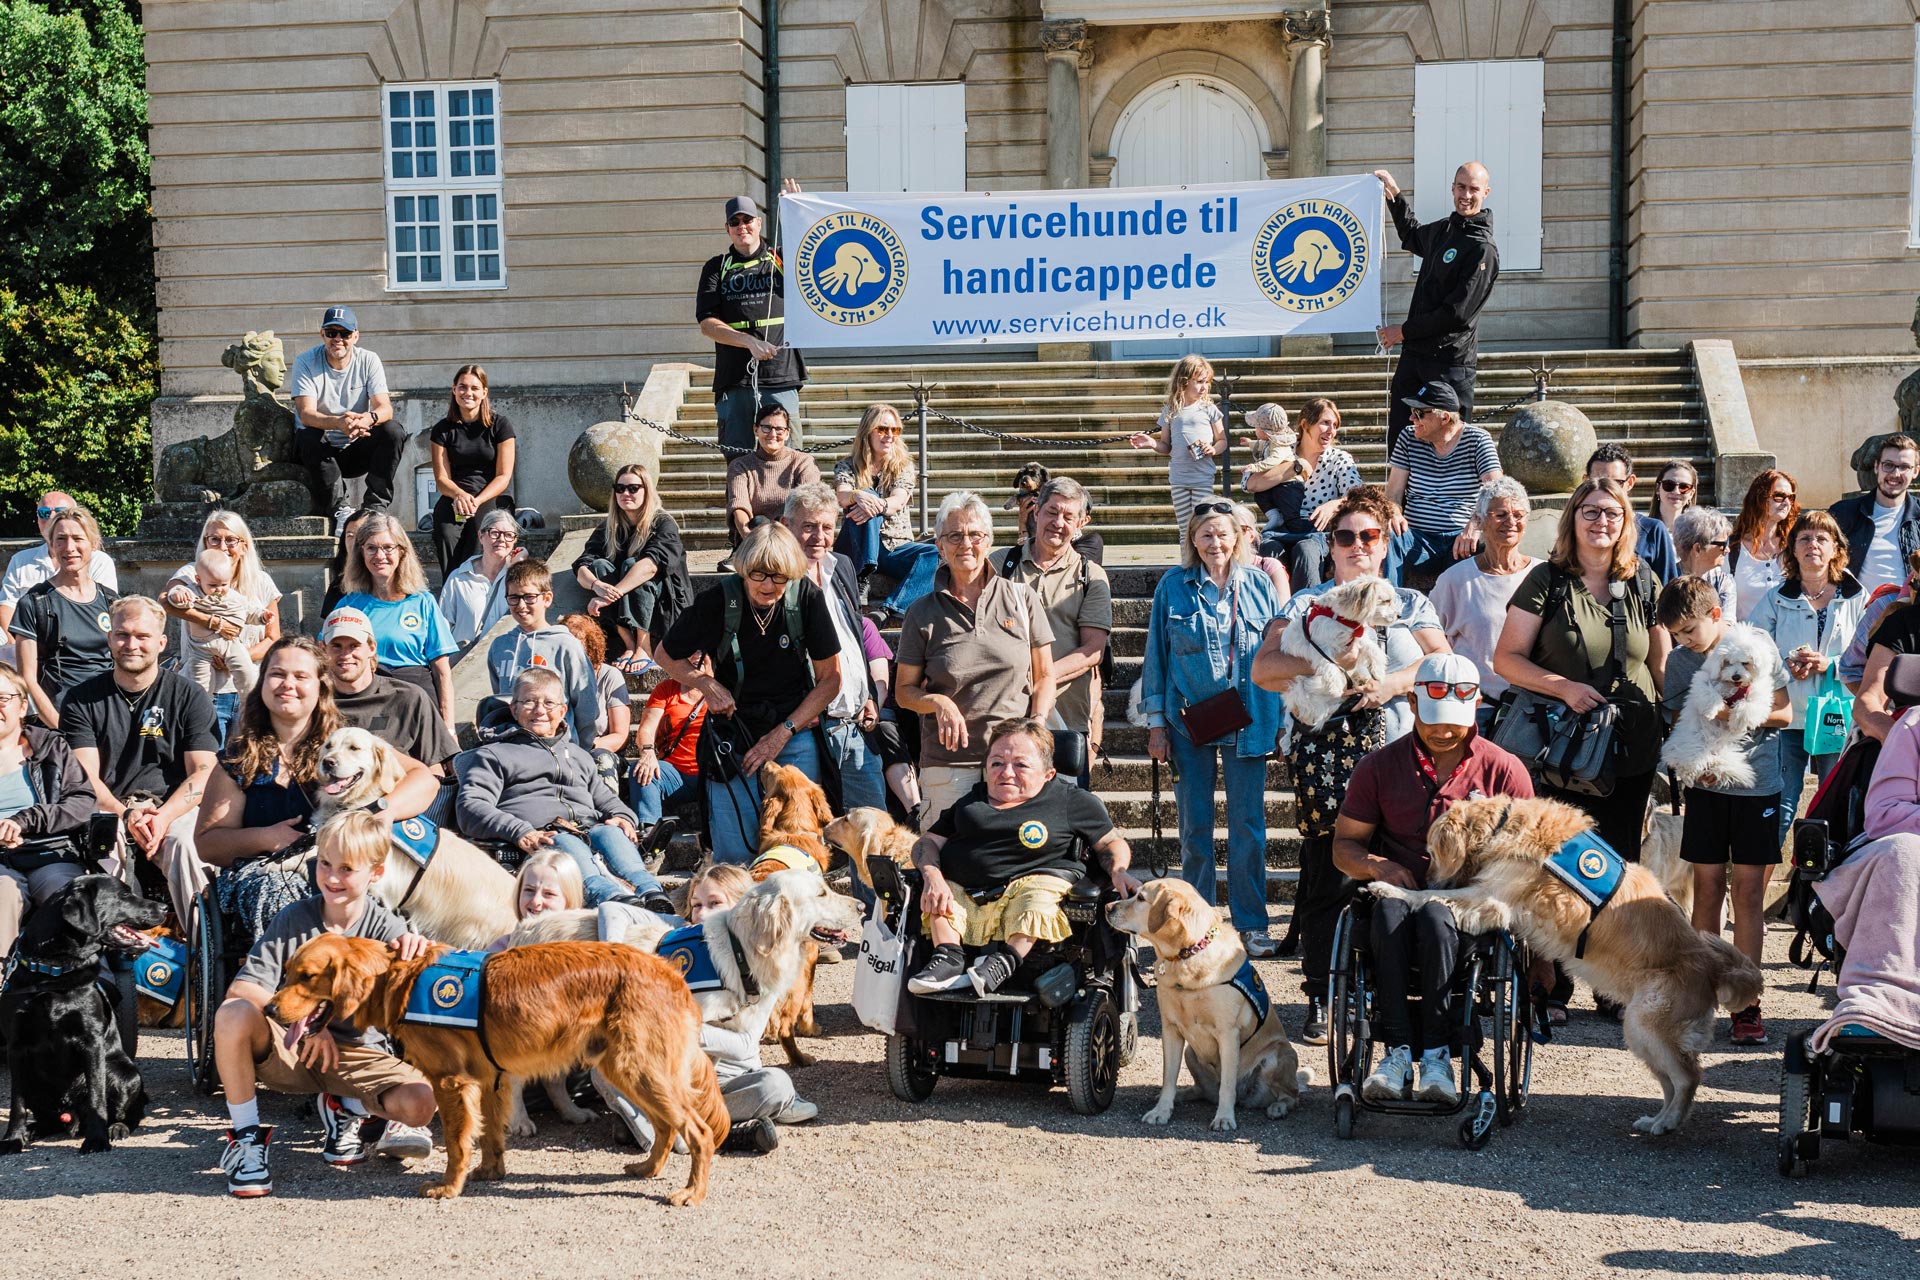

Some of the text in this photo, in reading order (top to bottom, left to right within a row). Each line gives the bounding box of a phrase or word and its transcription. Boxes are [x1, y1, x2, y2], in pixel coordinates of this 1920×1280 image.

[920, 197, 1238, 241] Servicehunde til
[799, 214, 906, 313] SERVICEHUNDE TIL HANDICAPPEDE
[1255, 202, 1366, 301] SERVICEHUNDE TIL HANDICAPPEDE
[943, 253, 1217, 301] handicappede
[839, 310, 866, 324] STH
[932, 306, 1227, 335] www.servicehunde.dk
[1297, 297, 1325, 311] STH
